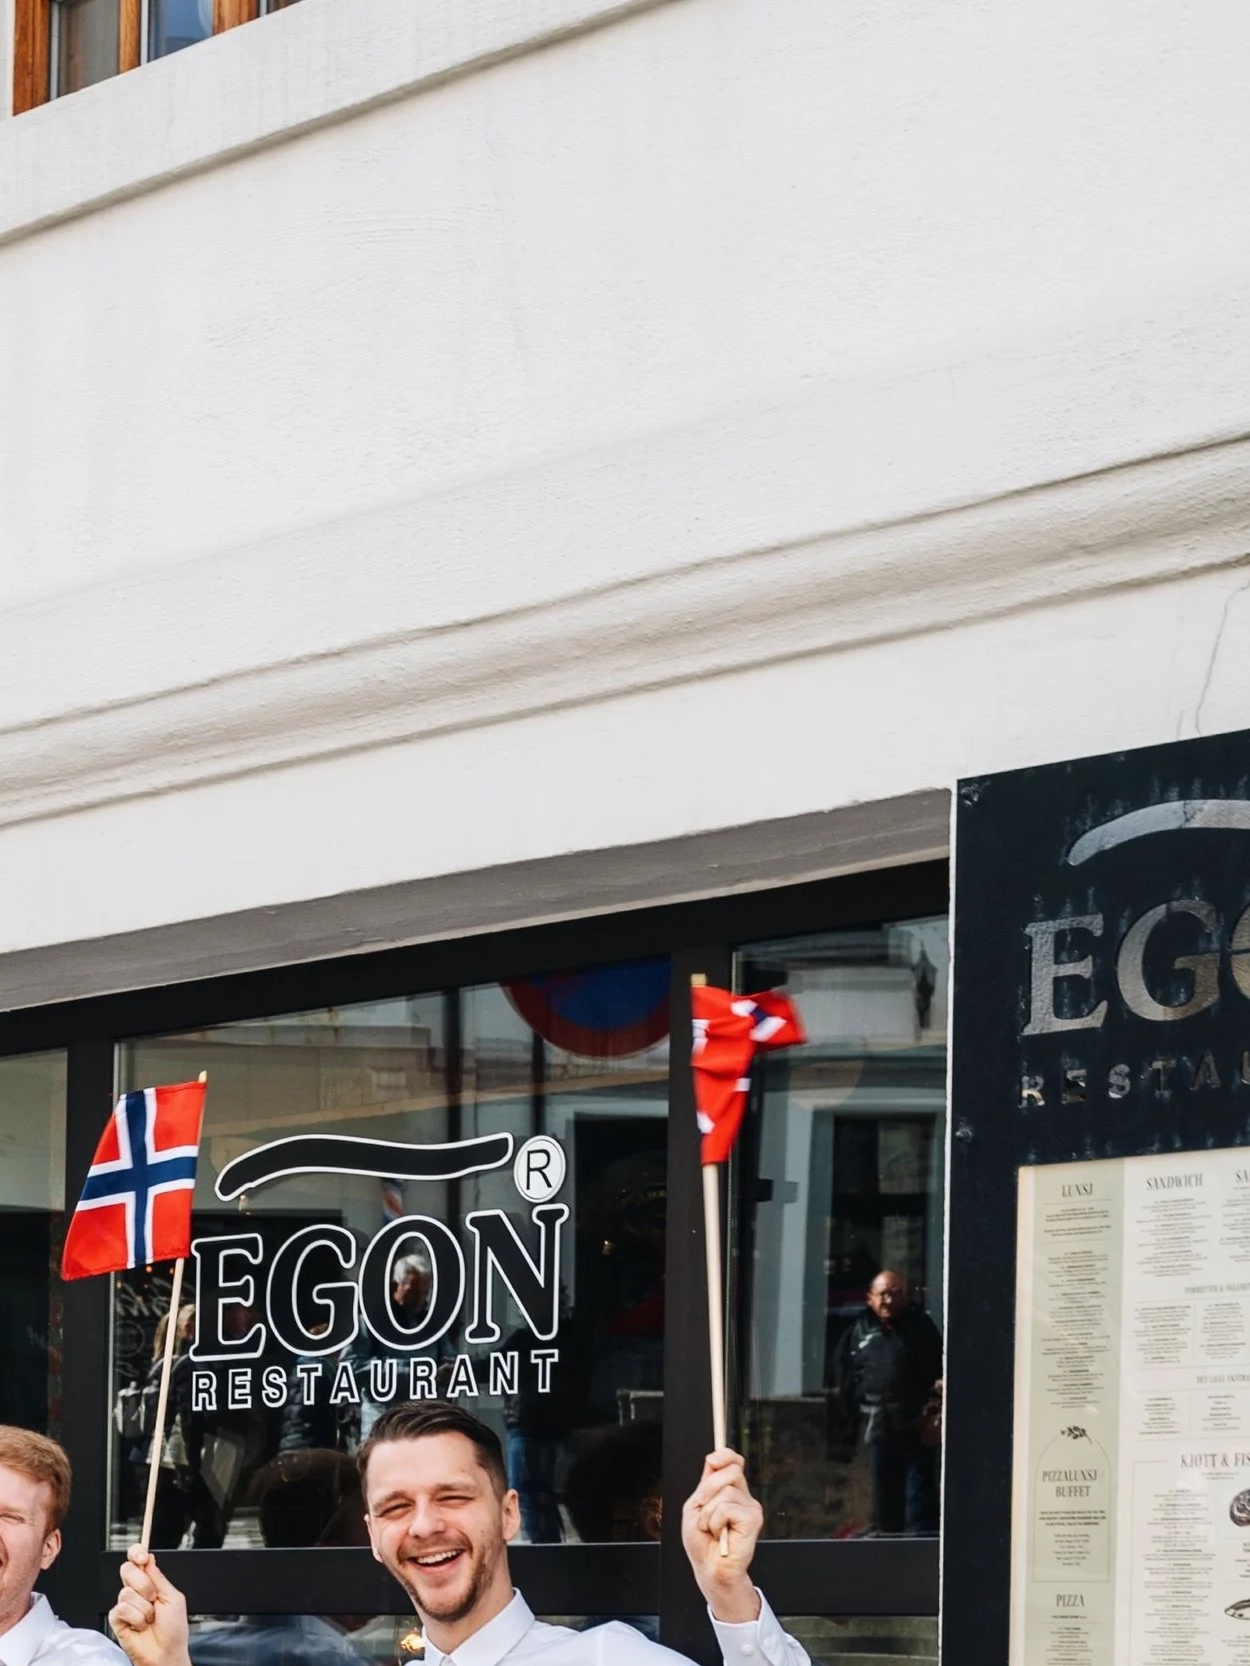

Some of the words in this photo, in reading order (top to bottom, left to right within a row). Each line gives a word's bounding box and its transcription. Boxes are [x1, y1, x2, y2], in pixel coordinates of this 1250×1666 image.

[1146, 1173, 1203, 1190] SANDWICH
[189, 1203, 570, 1362] EGON
[191, 1349, 560, 1411] RESTAURANT
[1055, 1485, 1091, 1498] BUFFET
[1056, 1594, 1085, 1607] PIZZA
